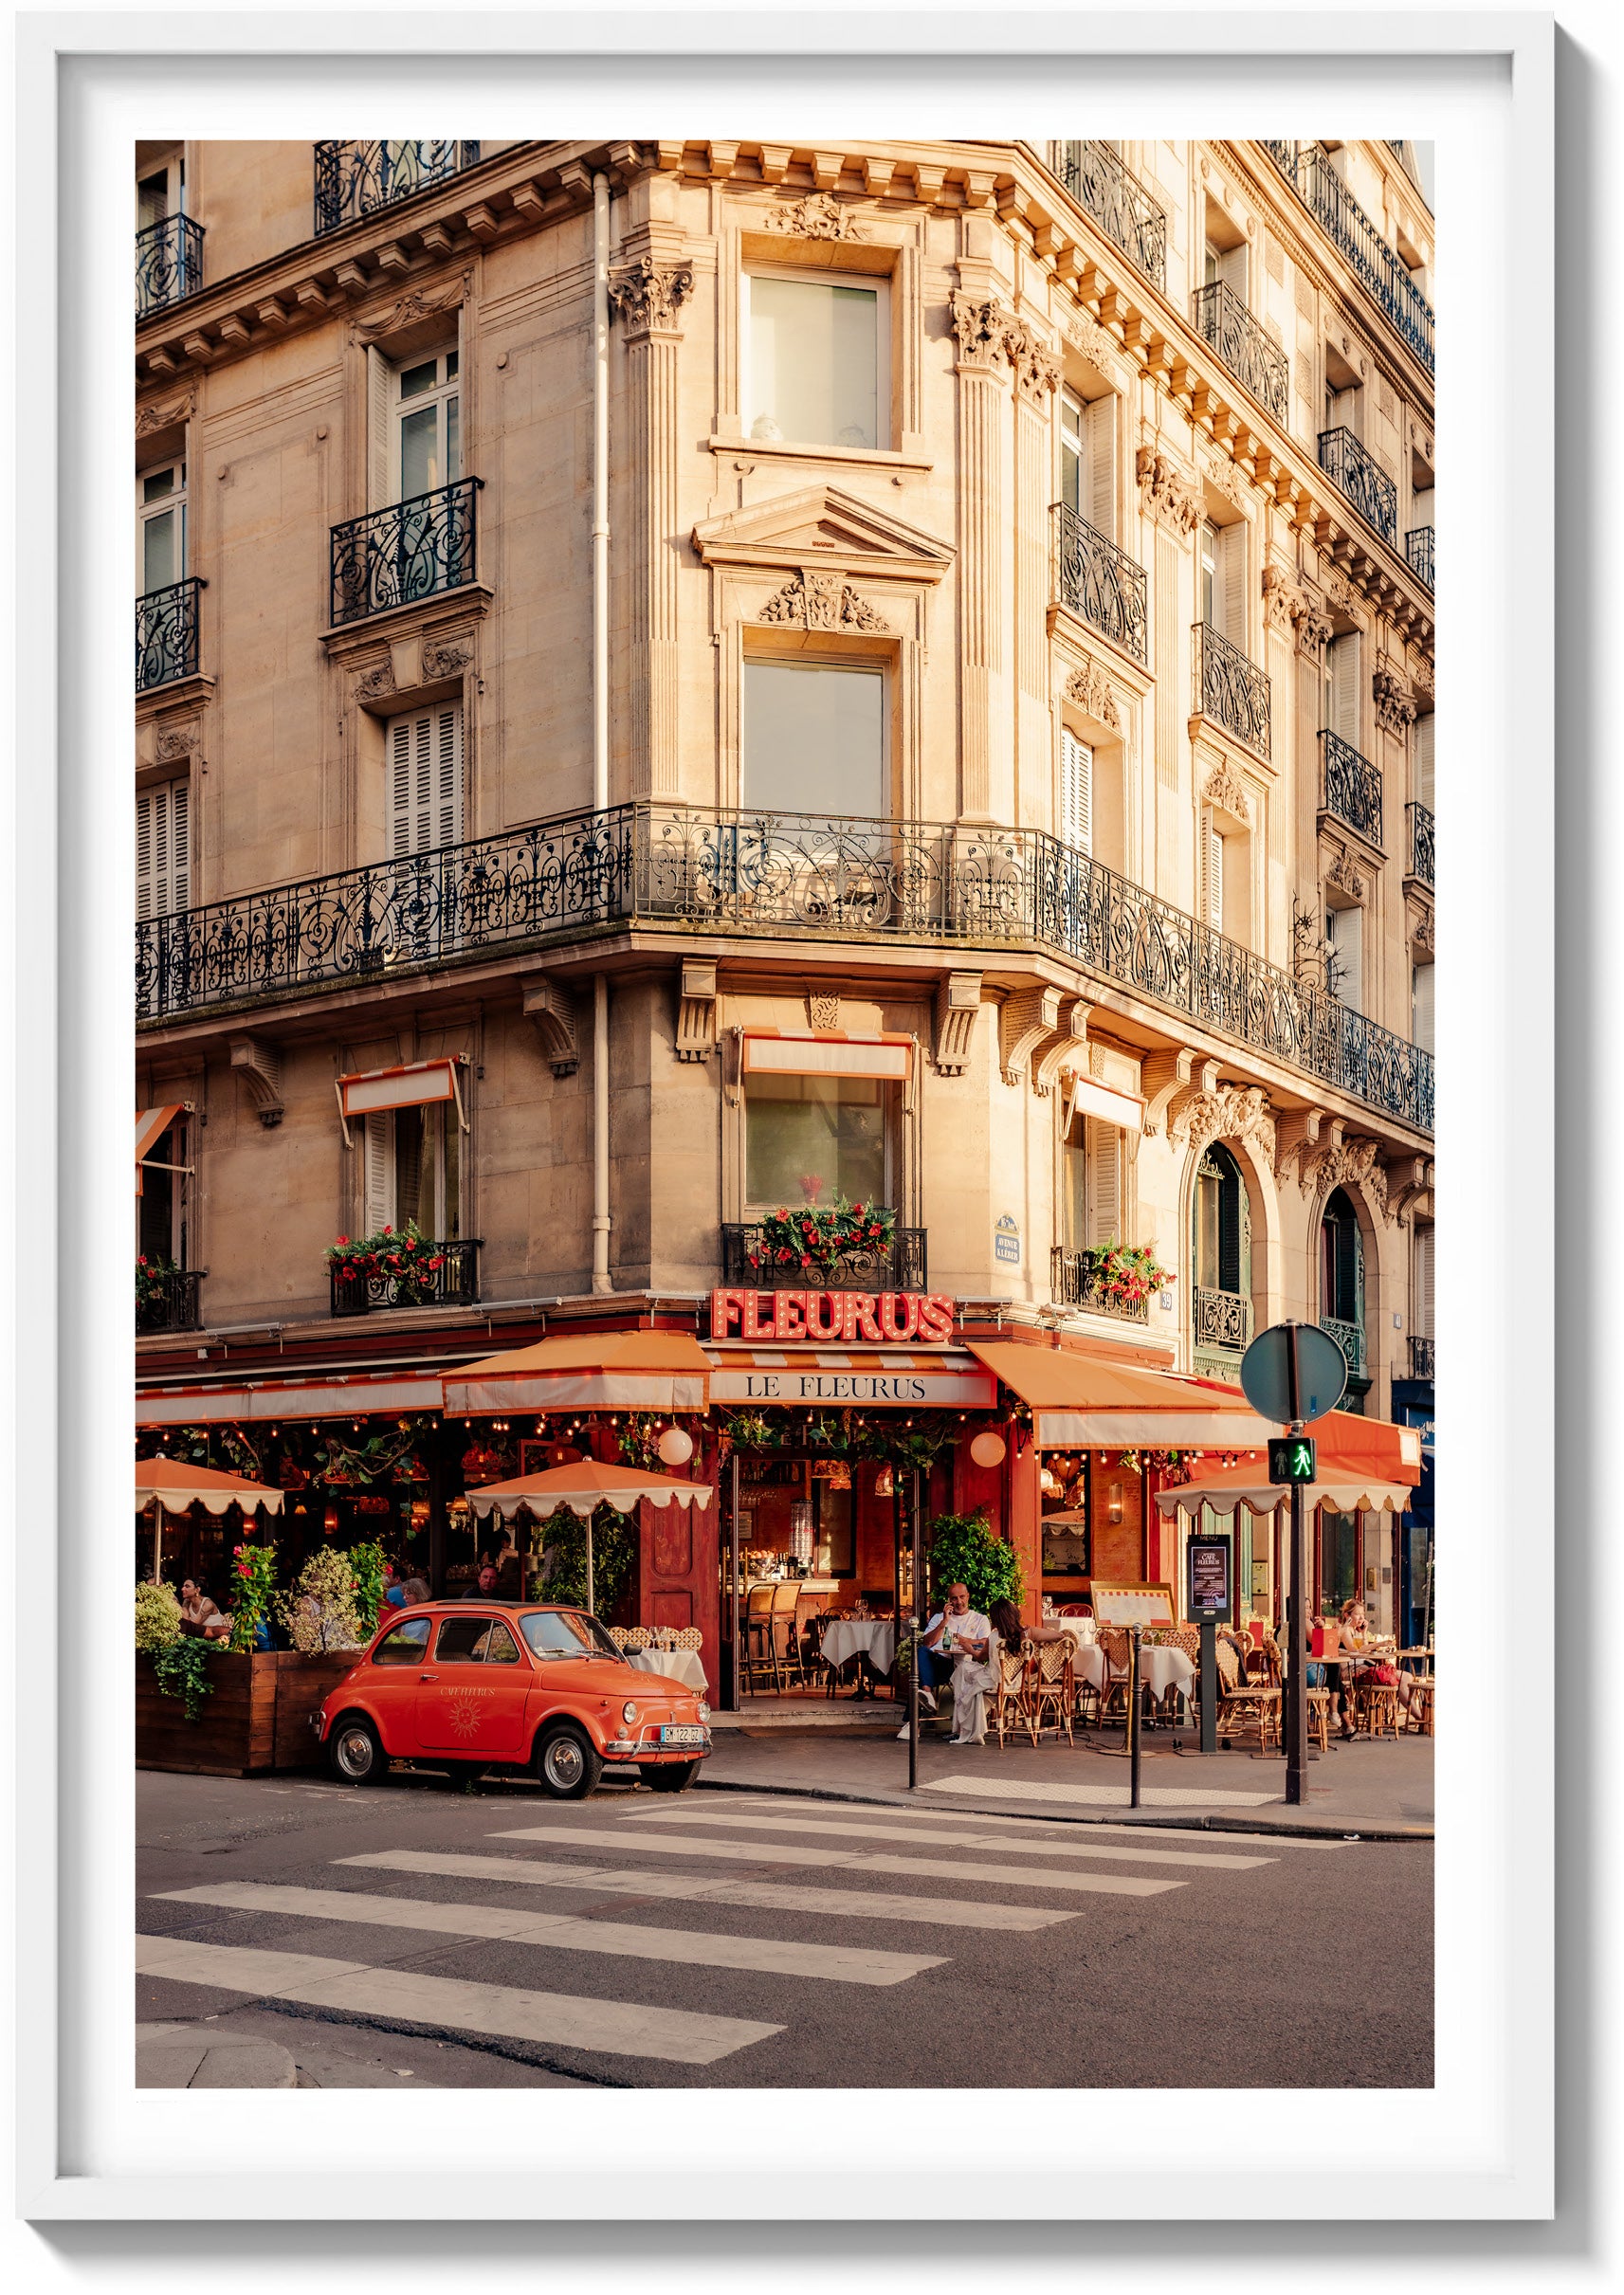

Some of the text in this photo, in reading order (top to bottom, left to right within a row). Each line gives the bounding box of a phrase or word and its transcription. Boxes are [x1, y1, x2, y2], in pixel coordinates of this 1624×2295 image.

[997, 1238, 1017, 1249] AVENUE
[996, 1248, 1018, 1261] KLÉBER
[1162, 1293, 1172, 1308] 39
[712, 1288, 954, 1341] FLEURUS
[745, 1375, 926, 1399] LE FLEURUS
